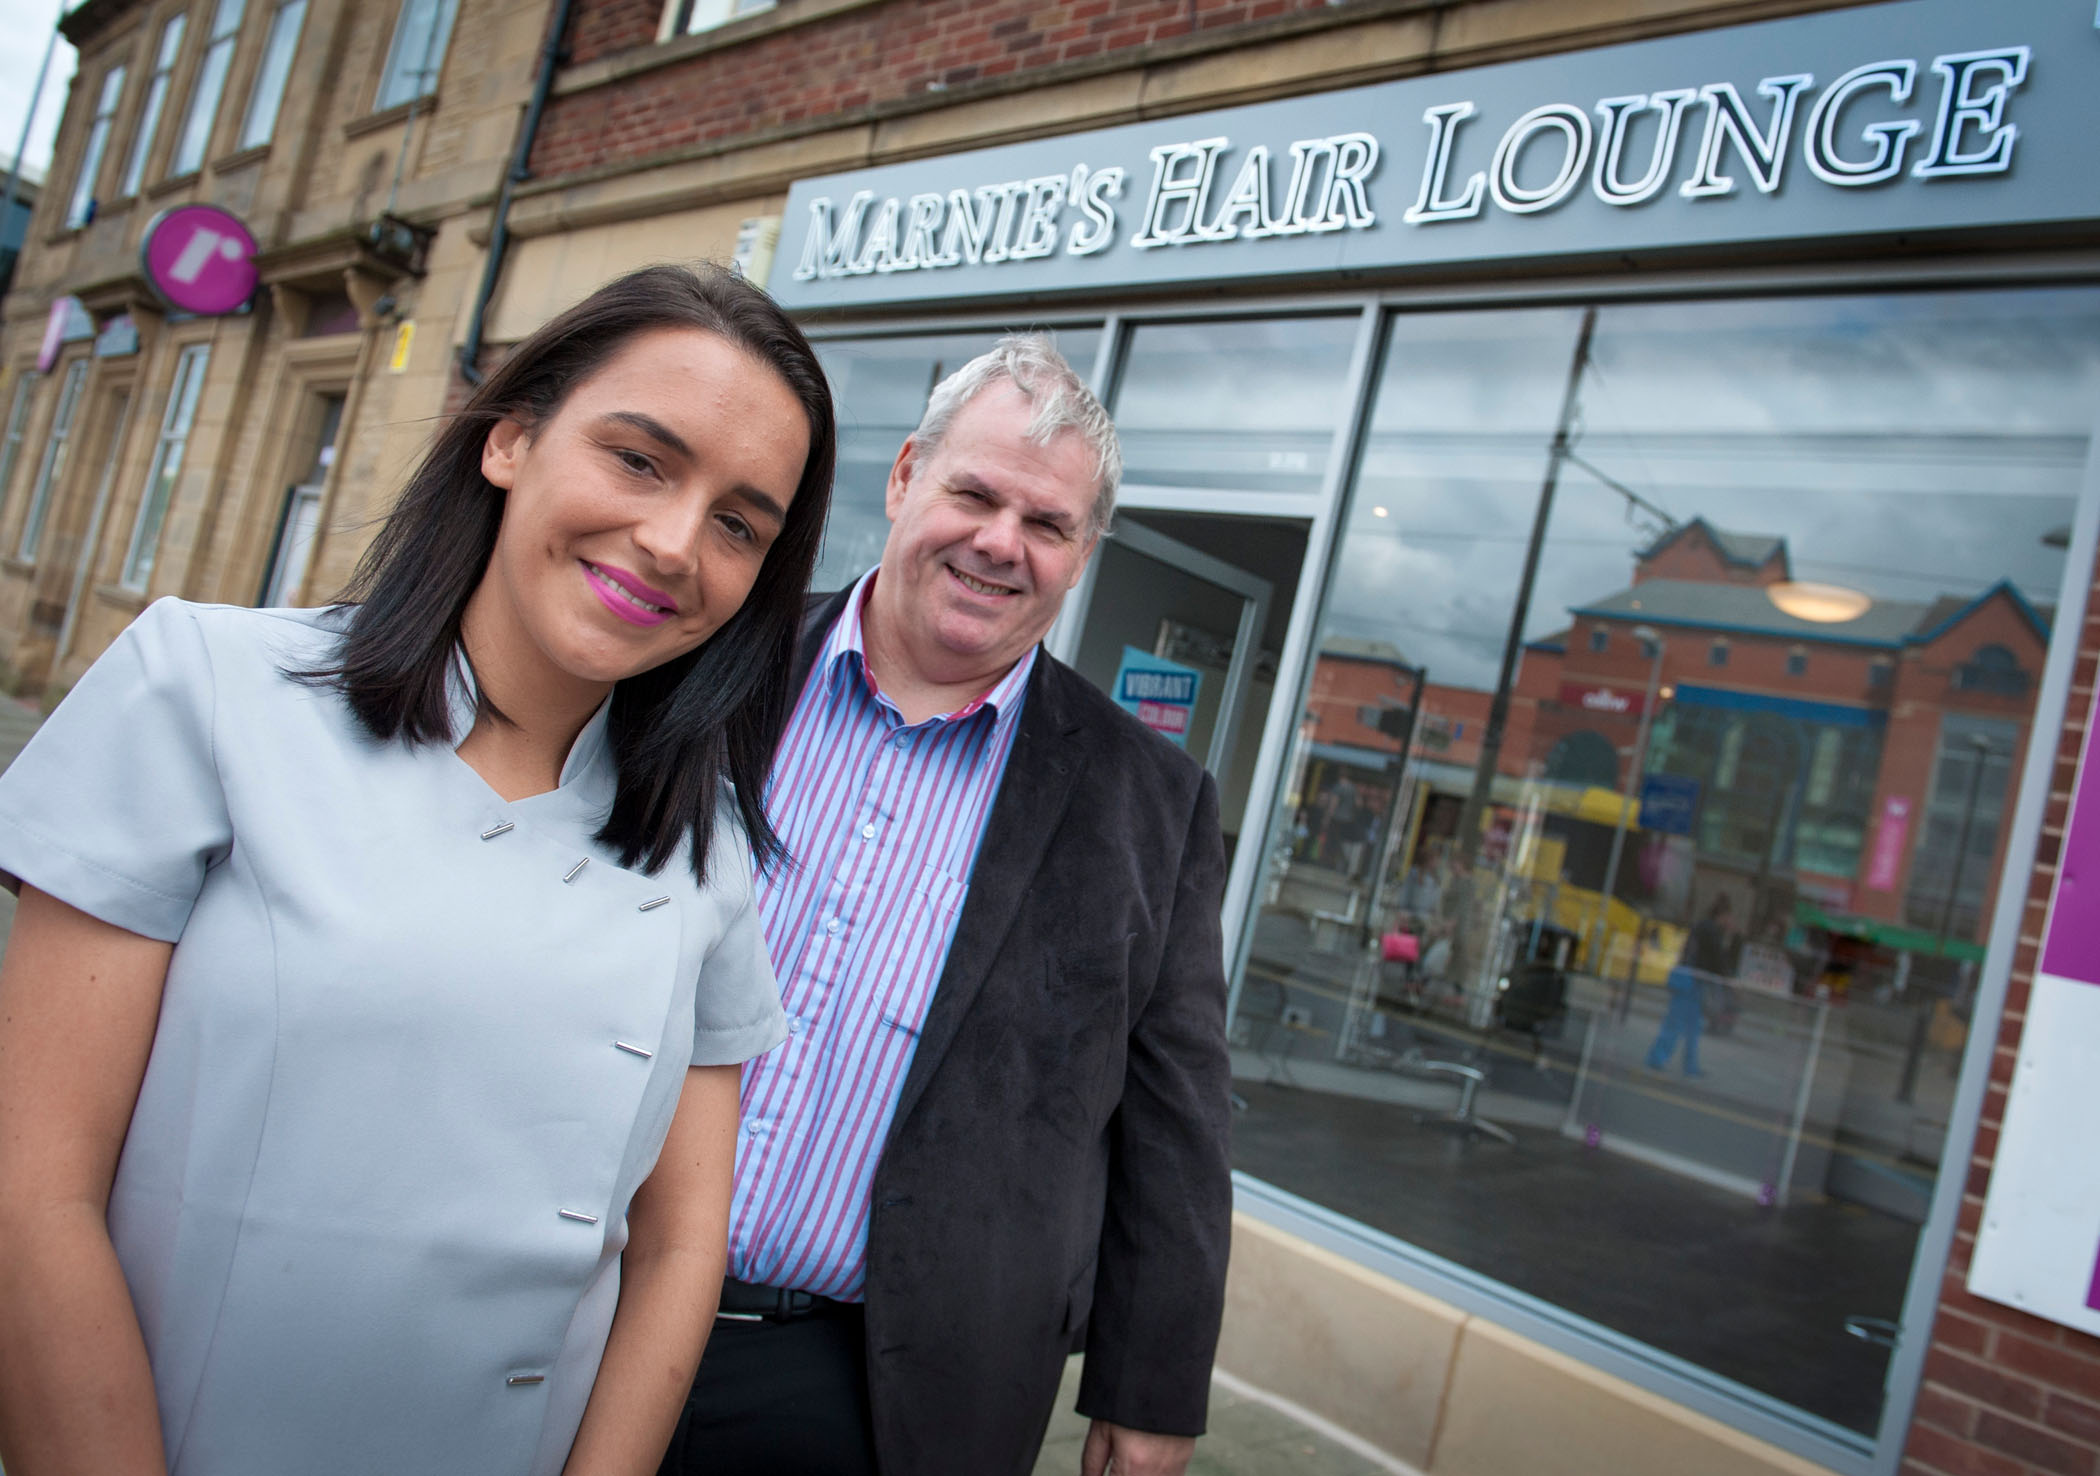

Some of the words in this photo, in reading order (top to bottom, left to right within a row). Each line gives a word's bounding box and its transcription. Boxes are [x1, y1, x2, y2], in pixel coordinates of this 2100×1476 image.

[793, 163, 1125, 281] MARNIE'S
[1131, 132, 1381, 248] HAIR
[1402, 45, 2032, 224] LOUNGE
[1126, 673, 1192, 698] VIBRANT
